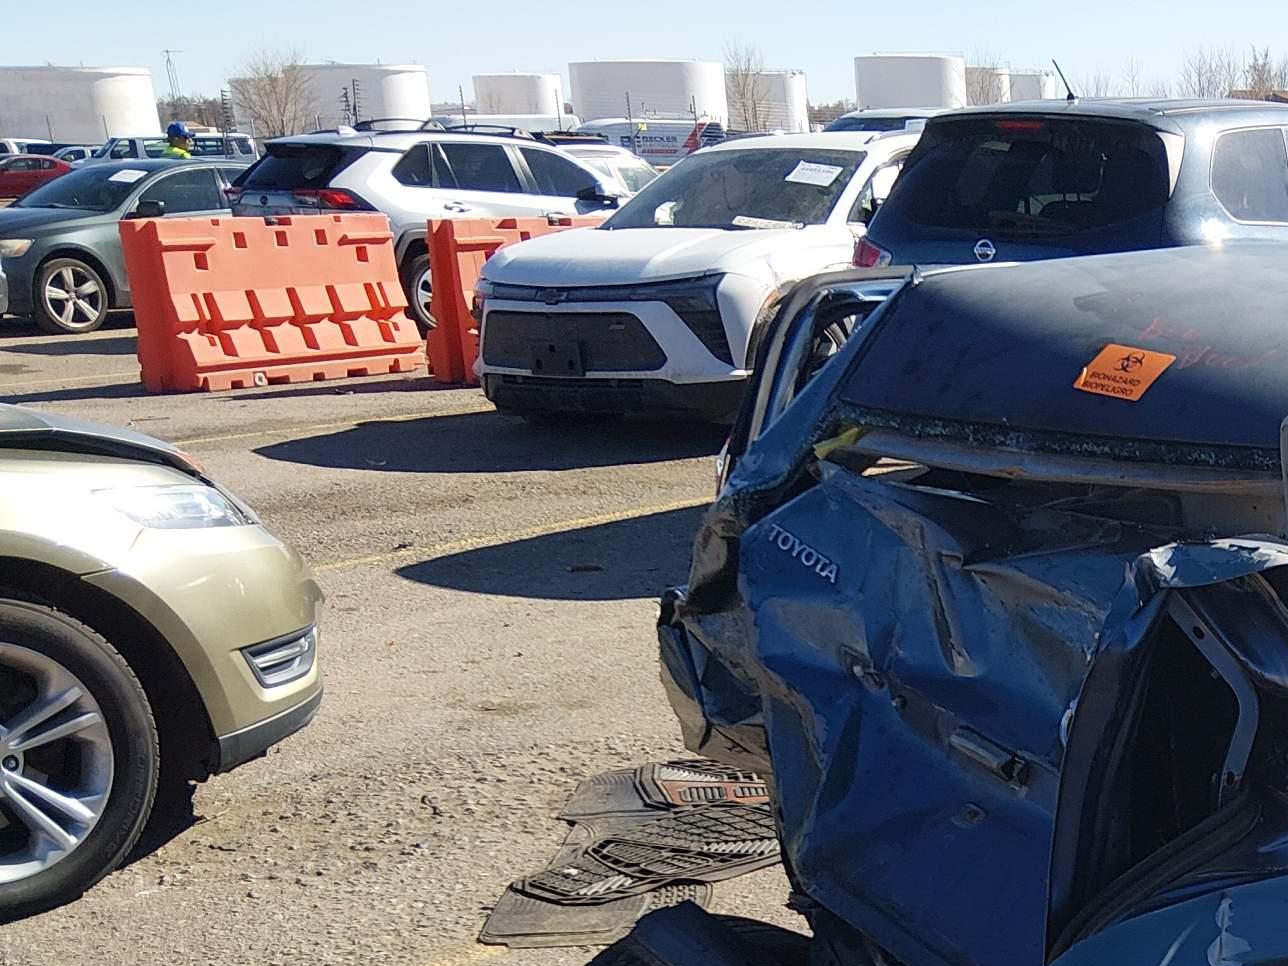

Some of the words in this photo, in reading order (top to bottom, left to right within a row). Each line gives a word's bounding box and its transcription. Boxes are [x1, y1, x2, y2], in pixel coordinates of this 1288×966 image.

[1089, 370, 1141, 387] BIOHAZARD
[1082, 380, 1133, 396] BIOPELIGRO
[768, 523, 838, 584] TOYOTA
